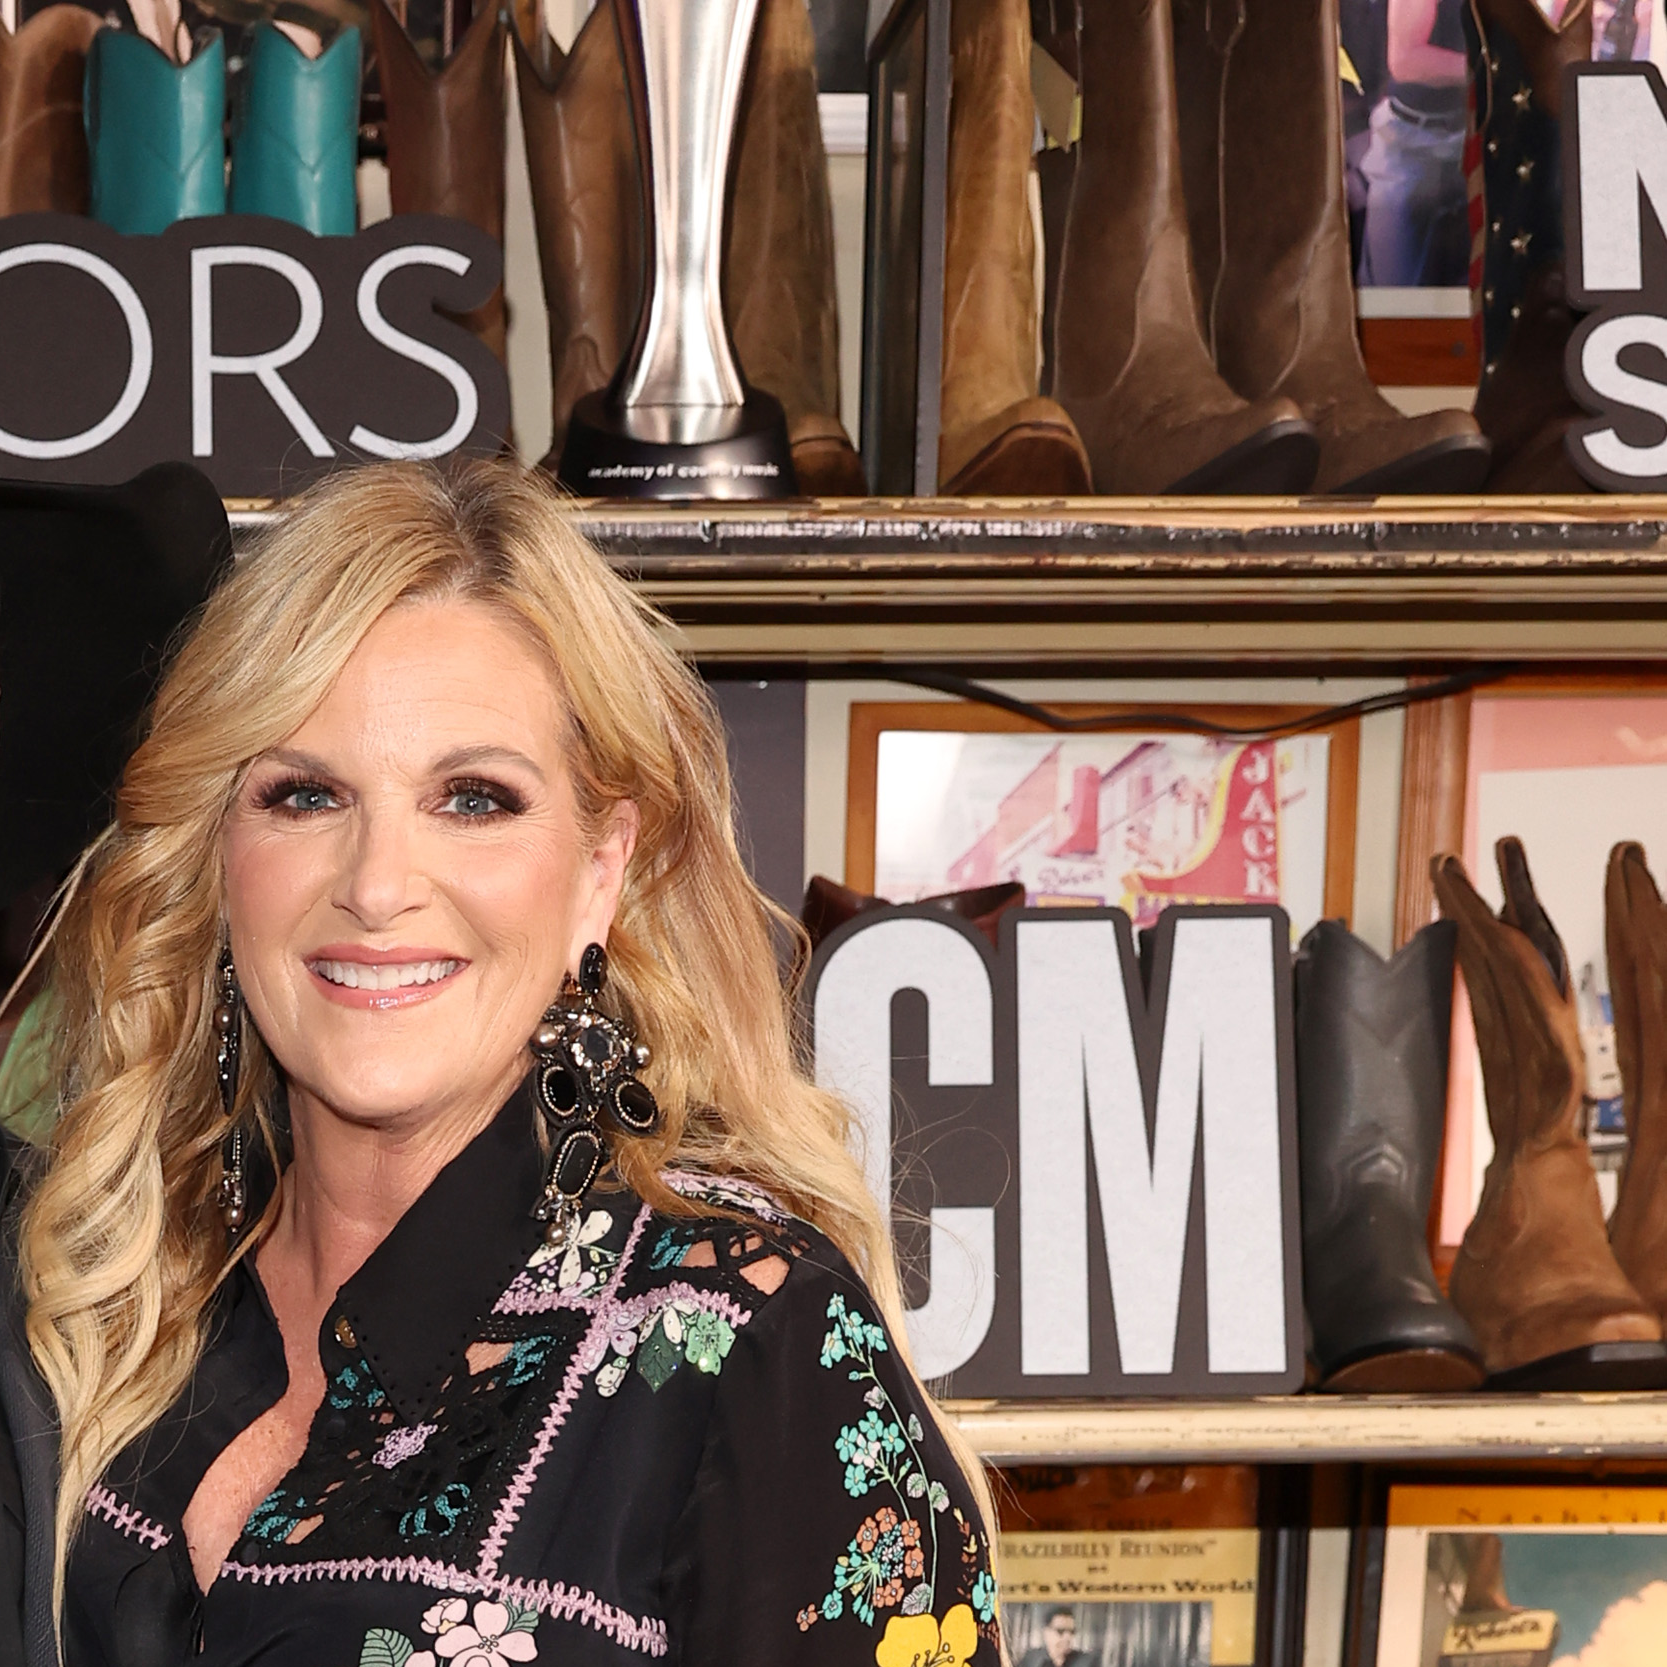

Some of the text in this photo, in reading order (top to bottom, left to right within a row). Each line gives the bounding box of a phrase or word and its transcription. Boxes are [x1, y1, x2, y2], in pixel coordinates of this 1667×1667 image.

[656, 463, 674, 478] of
[1056, 1579, 1167, 1594] Western
[1172, 1579, 1254, 1594] World
